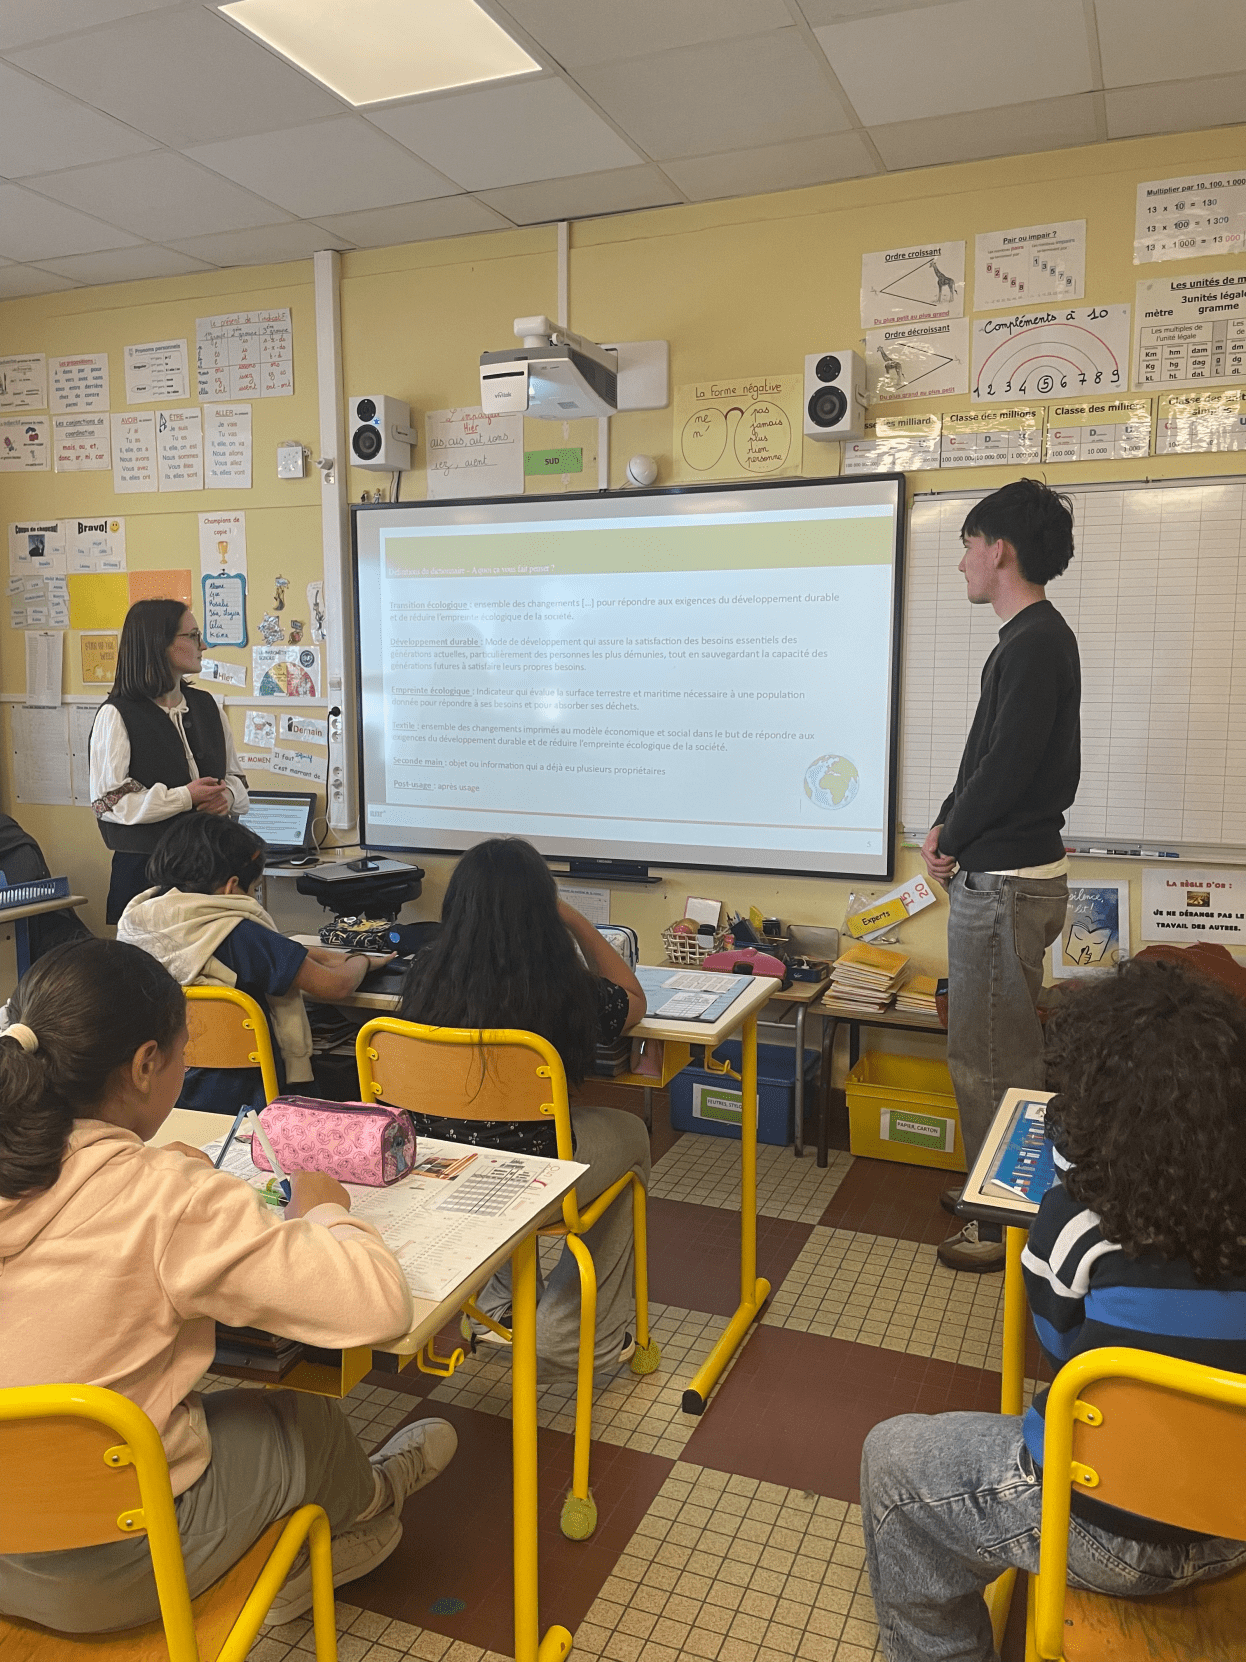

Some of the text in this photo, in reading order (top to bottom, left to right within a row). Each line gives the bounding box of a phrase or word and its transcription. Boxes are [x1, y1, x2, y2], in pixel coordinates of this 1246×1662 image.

[1146, 187, 1180, 196] Multiplier
[1147, 206, 1157, 214] 13
[1202, 199, 1217, 207] 130
[1029, 233, 1051, 241] impair
[885, 248, 941, 262] Ordre croissant
[1190, 278, 1220, 287] unités
[1222, 276, 1234, 285] de
[1145, 302, 1239, 318] mètre gramme
[984, 308, 1108, 336] Compléments à 10
[885, 325, 950, 339] Ordre décroissant
[696, 387, 705, 398] La
[743, 379, 782, 400] négative
[973, 370, 1120, 398] 1 2 3 4 5 6 7 8 9
[751, 407, 769, 424] pas
[950, 414, 978, 423] Classe
[999, 410, 1036, 419] millions
[1055, 406, 1086, 416] Classe
[1088, 405, 1105, 413] des
[695, 414, 711, 424] ne
[464, 422, 479, 433] Hier
[750, 420, 783, 436] jamais
[748, 431, 768, 447] plus
[747, 445, 769, 454] rien
[465, 454, 487, 466] aient
[745, 454, 782, 469] personne
[78, 521, 107, 535] Bravo!
[204, 517, 231, 525] Champions
[390, 600, 425, 609] Transition
[427, 600, 467, 610] écologique
[474, 599, 511, 608] ensemble
[512, 599, 525, 607] des
[527, 599, 579, 609] changements
[596, 600, 616, 608] pour
[618, 597, 656, 608] répondre
[675, 596, 716, 606] exigences
[732, 594, 802, 606] développement
[804, 593, 840, 602] durable
[390, 637, 448, 647] Développement
[450, 637, 479, 645] durable
[485, 637, 507, 645] Mode
[520, 637, 581, 647] développement
[583, 637, 596, 647] qui
[635, 637, 682, 645] satisfaction
[684, 637, 699, 645] des
[701, 636, 734, 645] besoins
[735, 636, 779, 644] essentiels
[781, 636, 797, 644] des
[219, 672, 233, 681] Hier
[293, 725, 322, 737] Demain
[273, 764, 321, 780] C'est marrant de
[393, 755, 423, 765] Seconde
[424, 757, 443, 766] main
[448, 758, 467, 769] objet
[480, 759, 524, 770] information
[526, 762, 538, 772] qui
[546, 763, 563, 773] déjà
[577, 764, 612, 776] plusieurs
[614, 766, 666, 777] propriétaires
[393, 779, 480, 793] Post-usage après usage
[914, 883, 929, 898] 20
[1180, 880, 1203, 888] RÈGLE
[862, 911, 890, 926] Experts
[1179, 909, 1214, 918] DÉRANGE
[897, 1120, 939, 1134] PAPIER, CARTON
